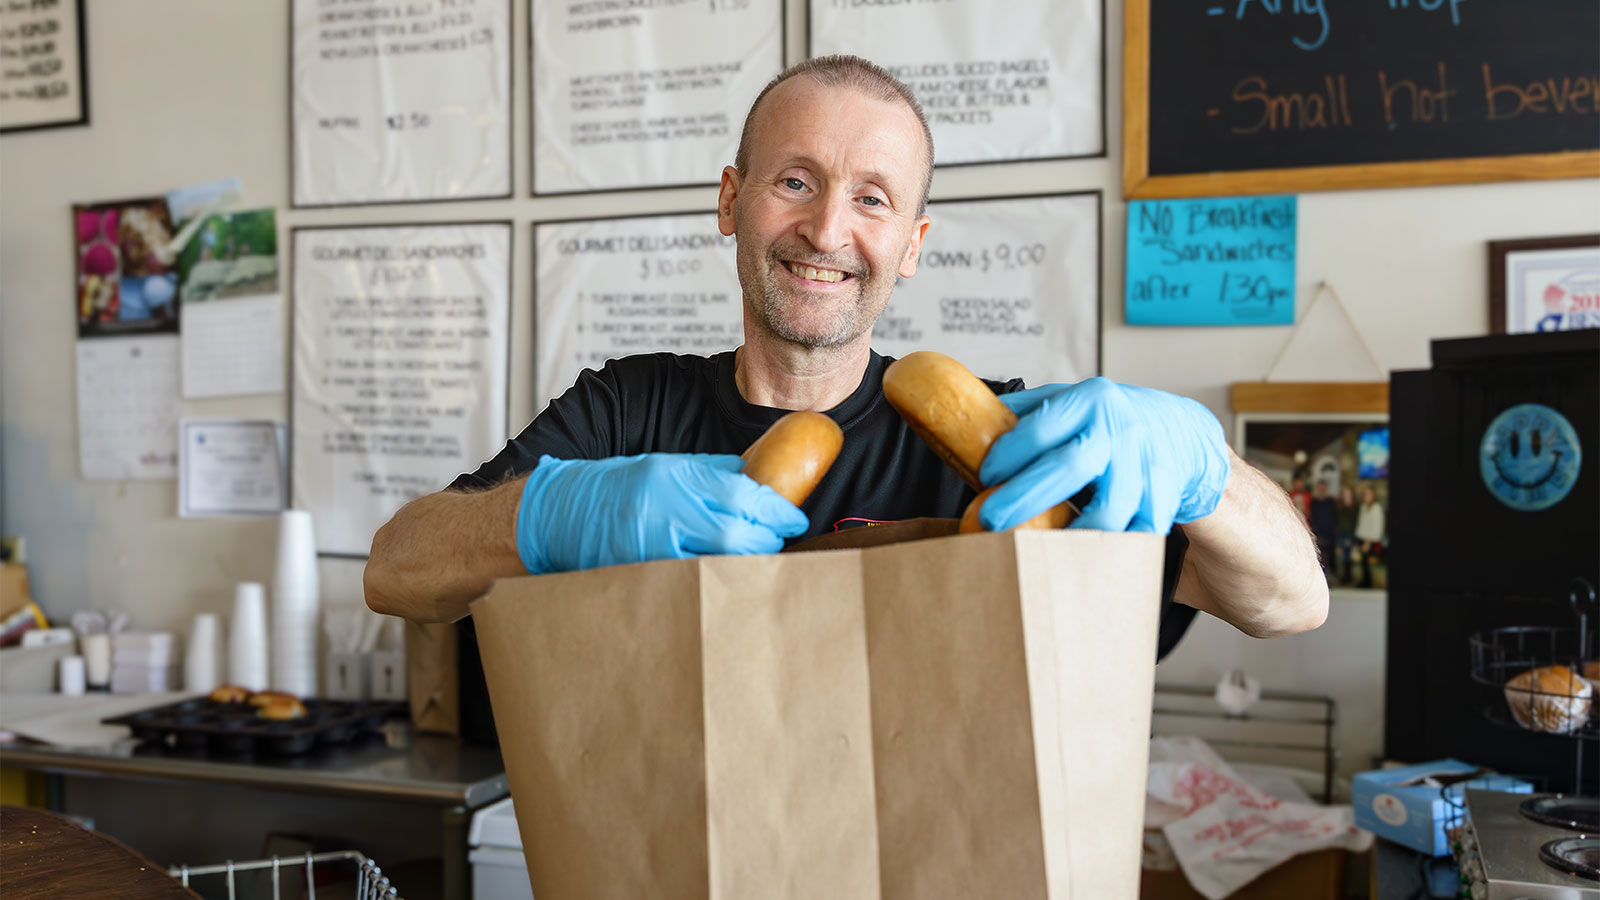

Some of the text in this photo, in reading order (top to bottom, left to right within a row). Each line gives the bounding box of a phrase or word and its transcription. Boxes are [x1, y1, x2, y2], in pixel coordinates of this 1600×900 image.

[888, 59, 1050, 79] NCLUDES SLICED BAGELS
[996, 75, 1049, 90] FLAVOR
[1379, 60, 1456, 123] hot
[937, 110, 993, 125] PACKETS
[557, 236, 627, 256] GOURMET
[629, 234, 662, 253] DELI
[1131, 274, 1193, 303] after
